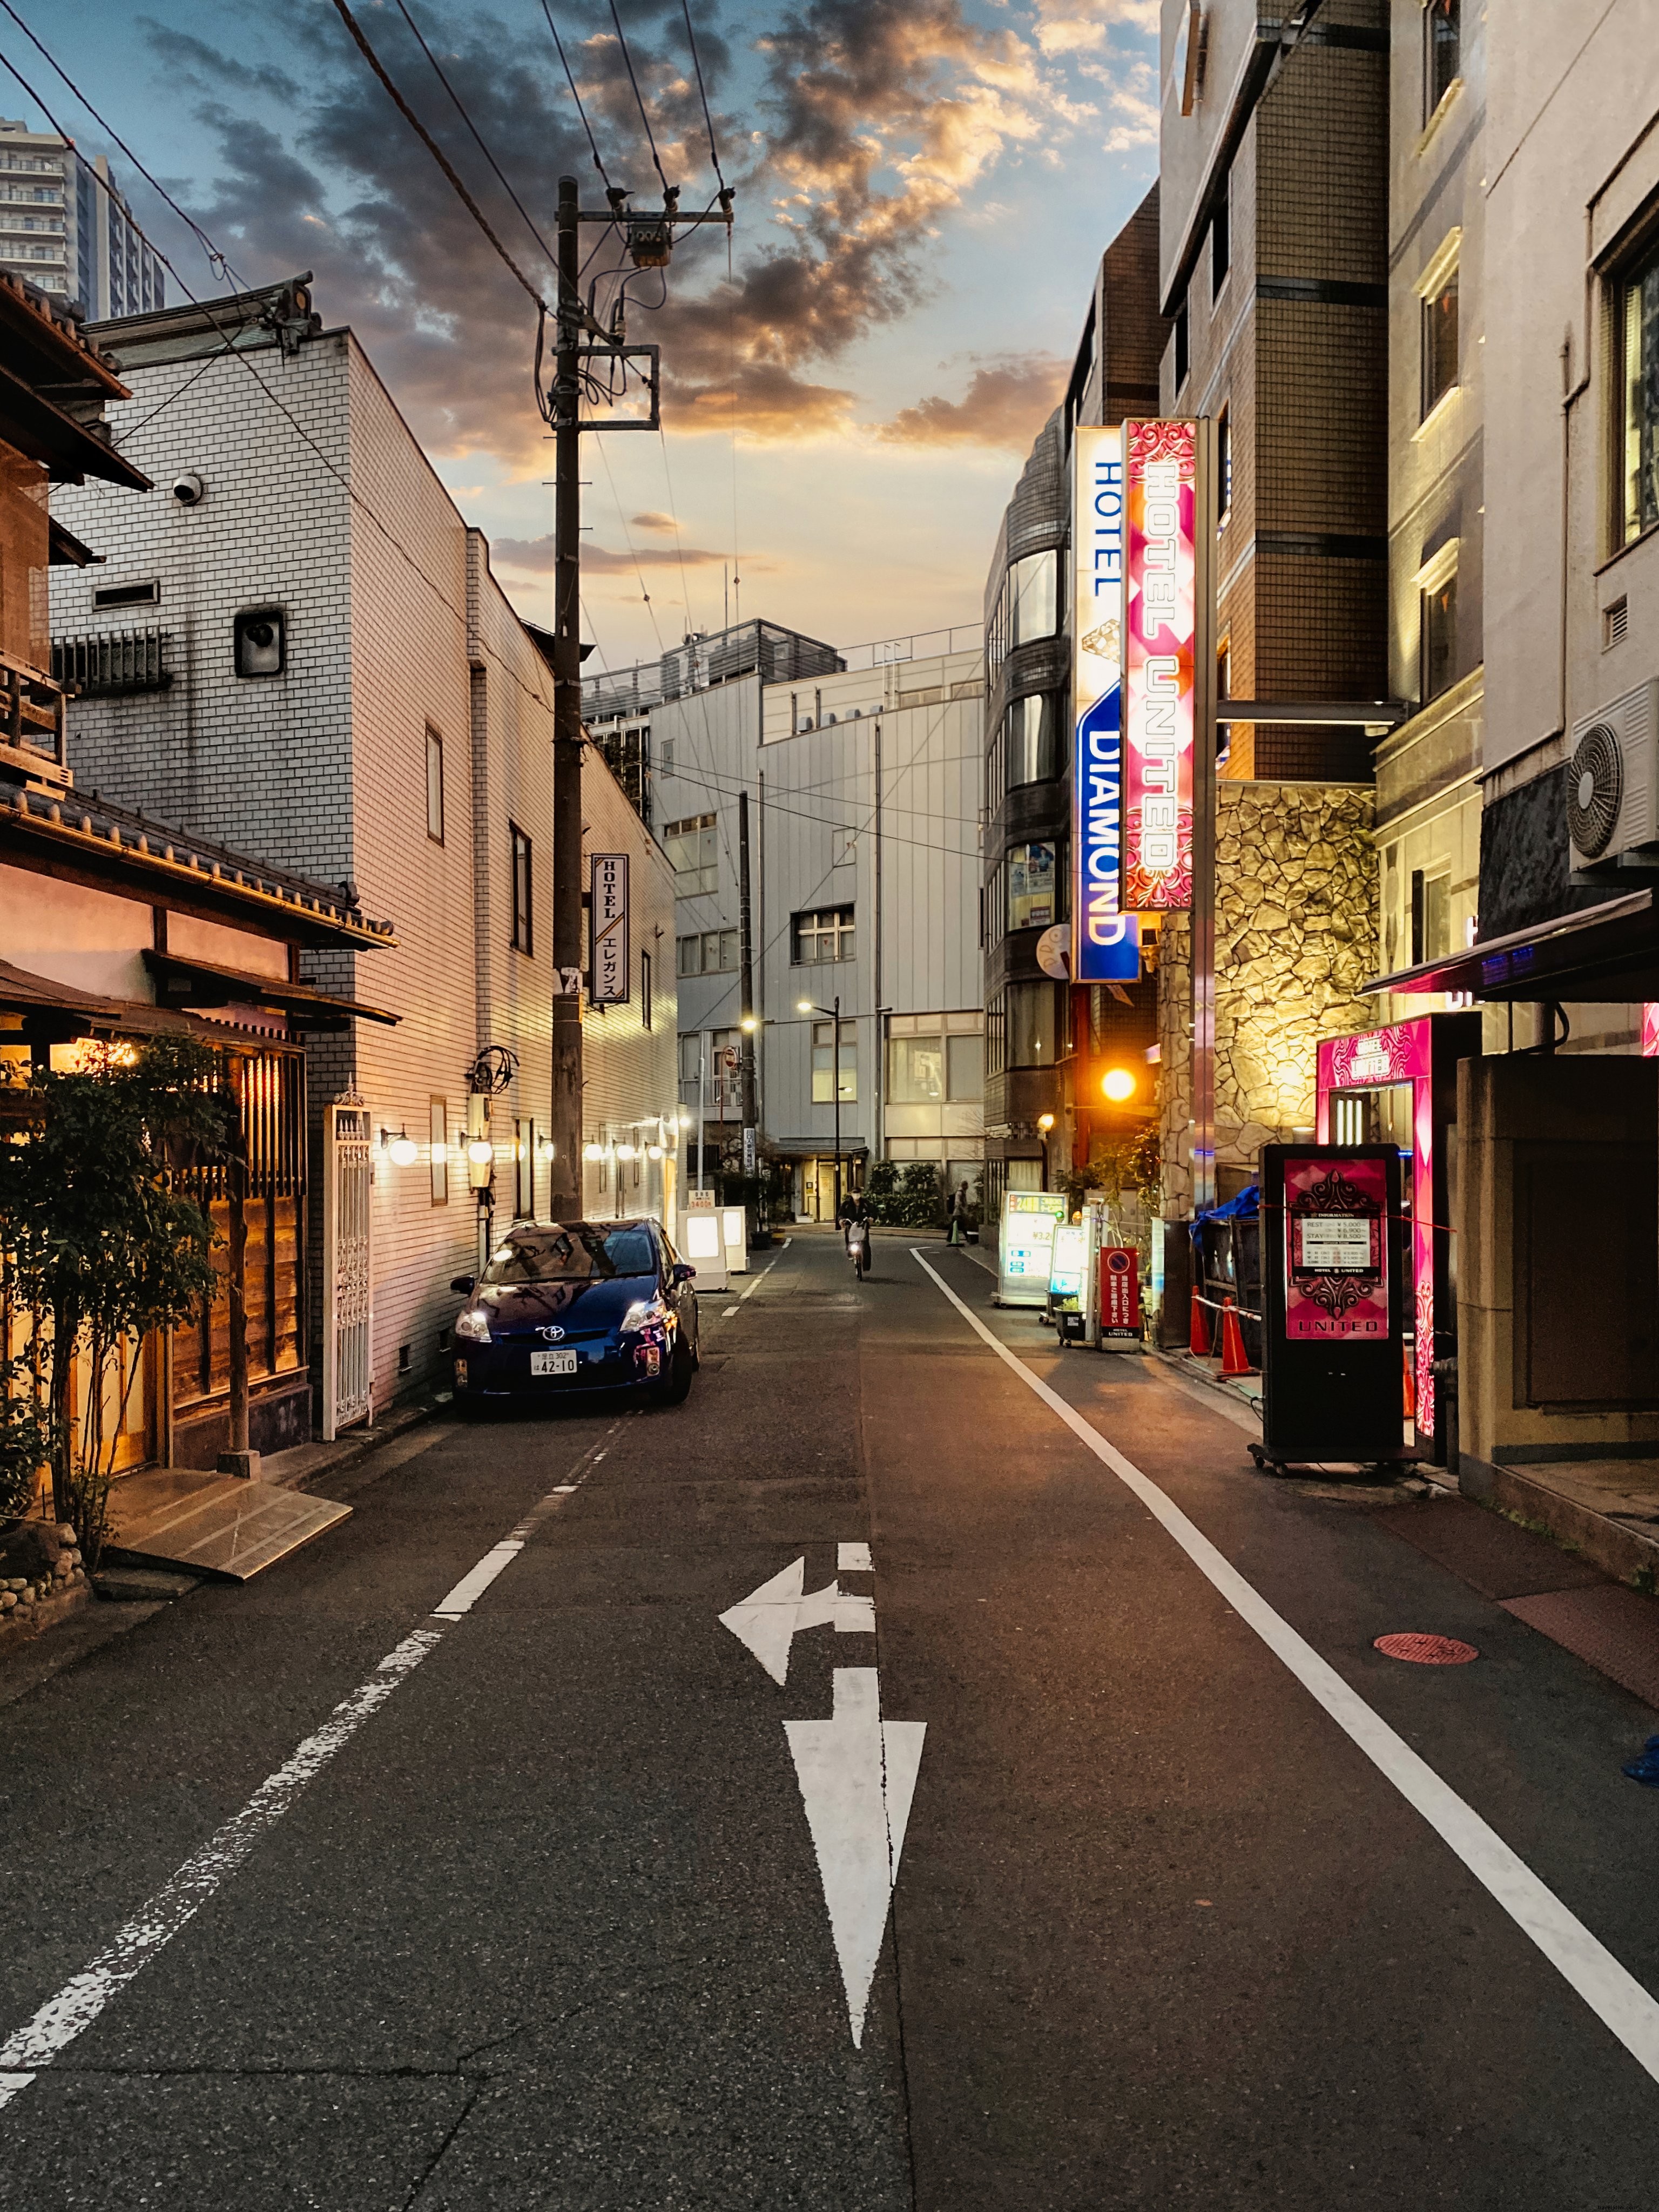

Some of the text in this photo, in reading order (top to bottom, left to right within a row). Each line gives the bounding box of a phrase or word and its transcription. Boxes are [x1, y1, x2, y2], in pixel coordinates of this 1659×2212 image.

[1095, 462, 1122, 597] HOTEL
[1144, 463, 1177, 868] HOTEL UNITED
[1088, 730, 1126, 946] DIAMOND
[603, 861, 616, 919] HOTEL
[603, 938, 617, 996] エレガンス
[1299, 1321, 1378, 1332] UNITED
[541, 1359, 574, 1373] 42-10
